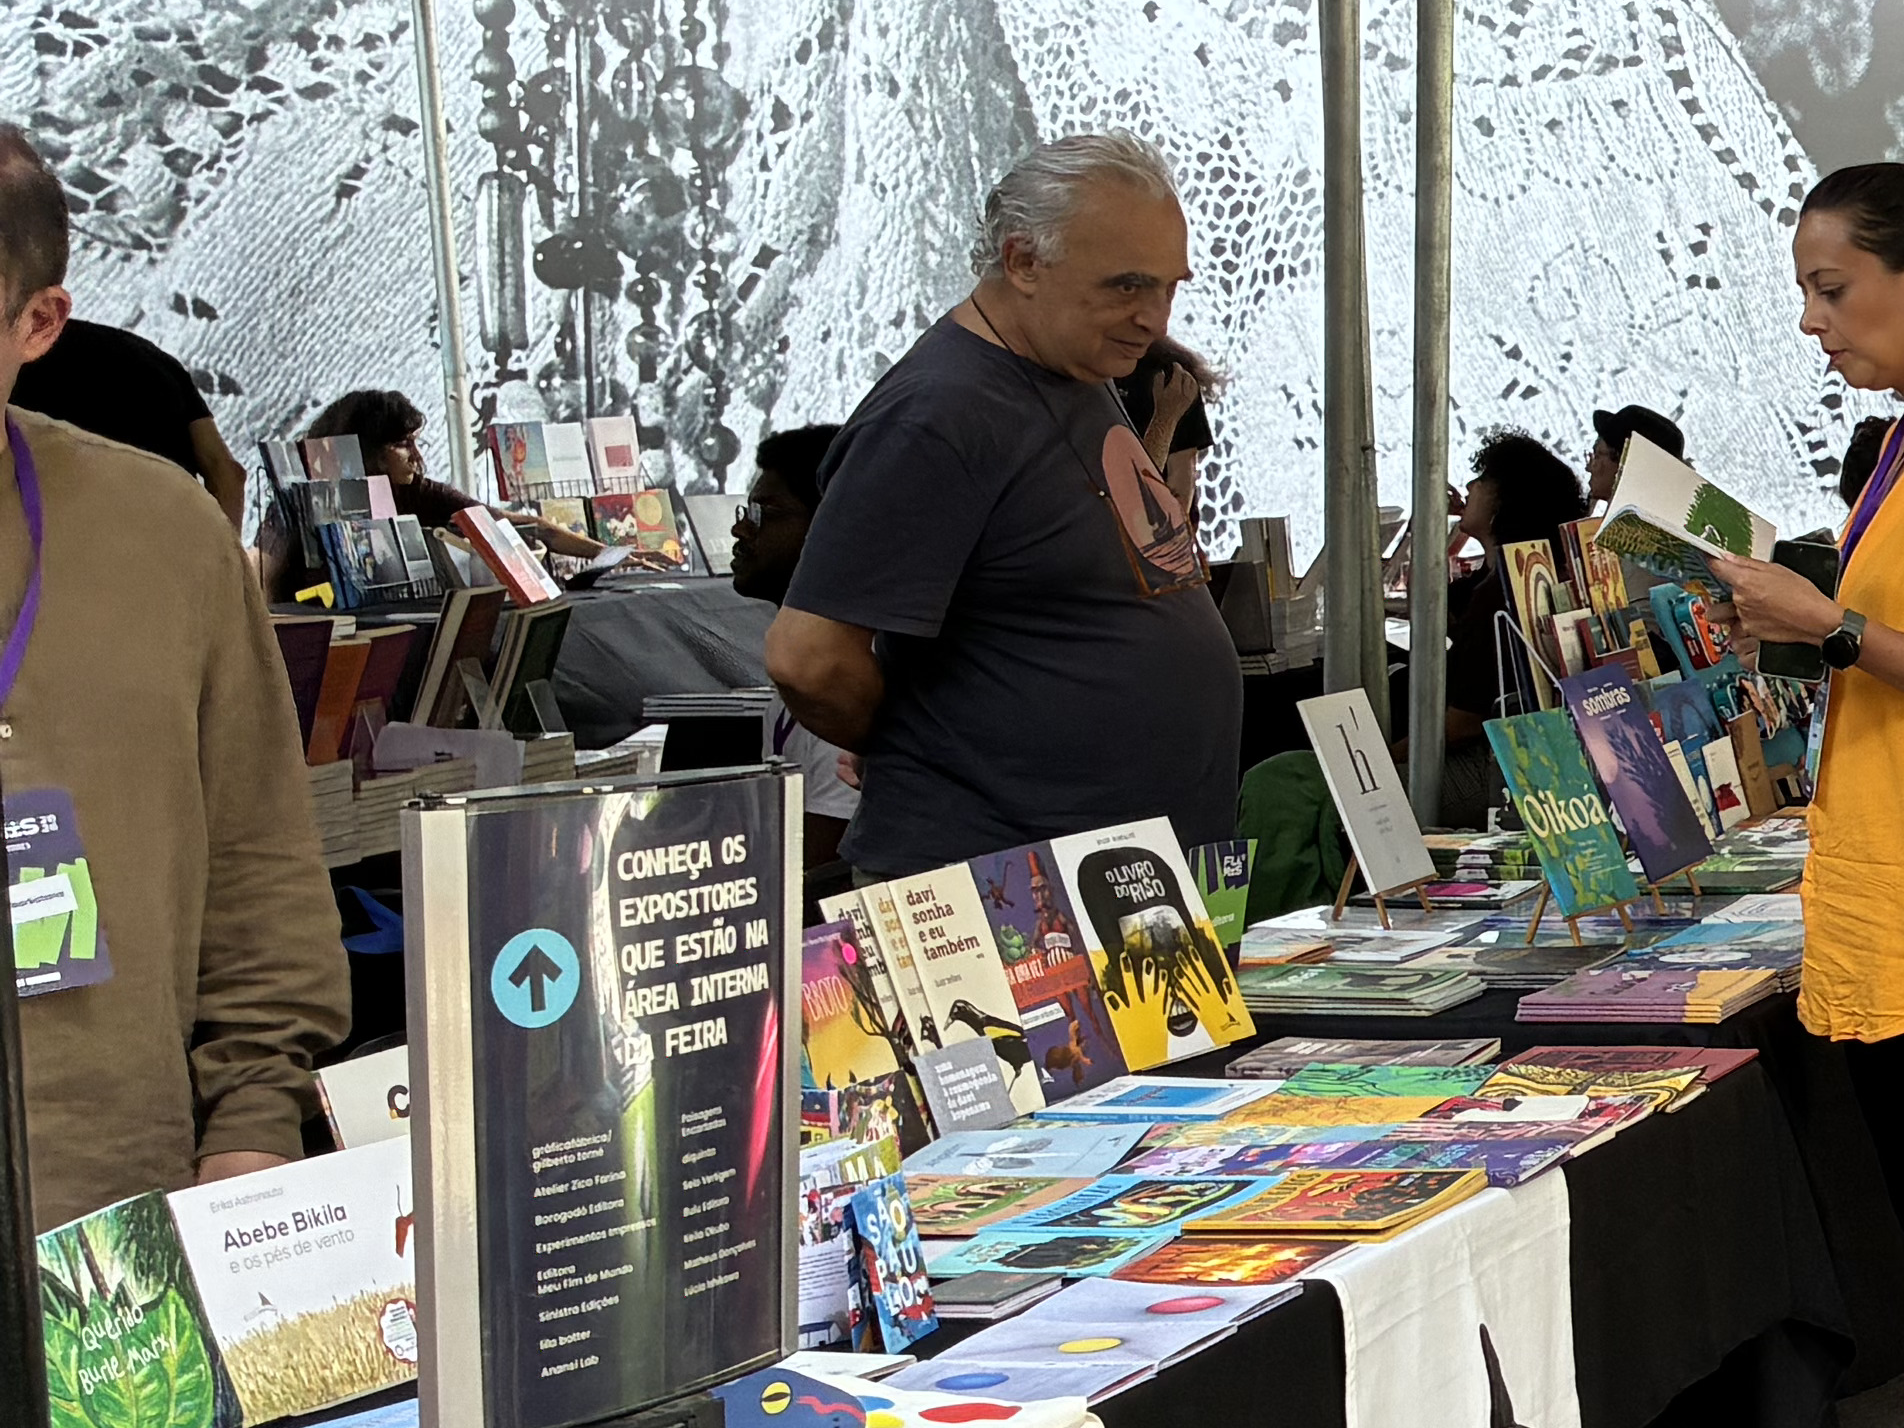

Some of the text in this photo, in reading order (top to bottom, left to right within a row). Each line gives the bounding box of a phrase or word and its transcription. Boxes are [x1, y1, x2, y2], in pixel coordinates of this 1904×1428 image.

[1582, 686, 1631, 717] sombras
[1523, 784, 1609, 840] Oikoá
[617, 834, 747, 880] CONHEÇA OS
[1105, 860, 1155, 883] O LIVRO
[619, 877, 758, 927] EXPOSITORES
[906, 884, 936, 906] davi
[1114, 878, 1166, 904] DO RISO
[912, 902, 955, 924] sonha
[621, 917, 769, 976] QUE ESTÃO NA
[919, 924, 946, 943] e eu
[924, 934, 980, 961] também
[625, 963, 769, 1018] ÁREA INTERNA
[665, 1017, 728, 1057] FEIRA
[210, 1187, 284, 1213] Erika Astronauta
[533, 1182, 569, 1198] Atelier
[535, 1198, 624, 1226] Borogodó Editora
[224, 1203, 347, 1252] Abebe Bikila
[229, 1227, 355, 1273] e os pés de vento
[536, 1230, 607, 1254] Experimentos
[537, 1265, 576, 1282] Editora
[537, 1281, 561, 1295] Meu
[584, 1273, 598, 1284] de
[78, 1333, 170, 1395] Burle Marx
